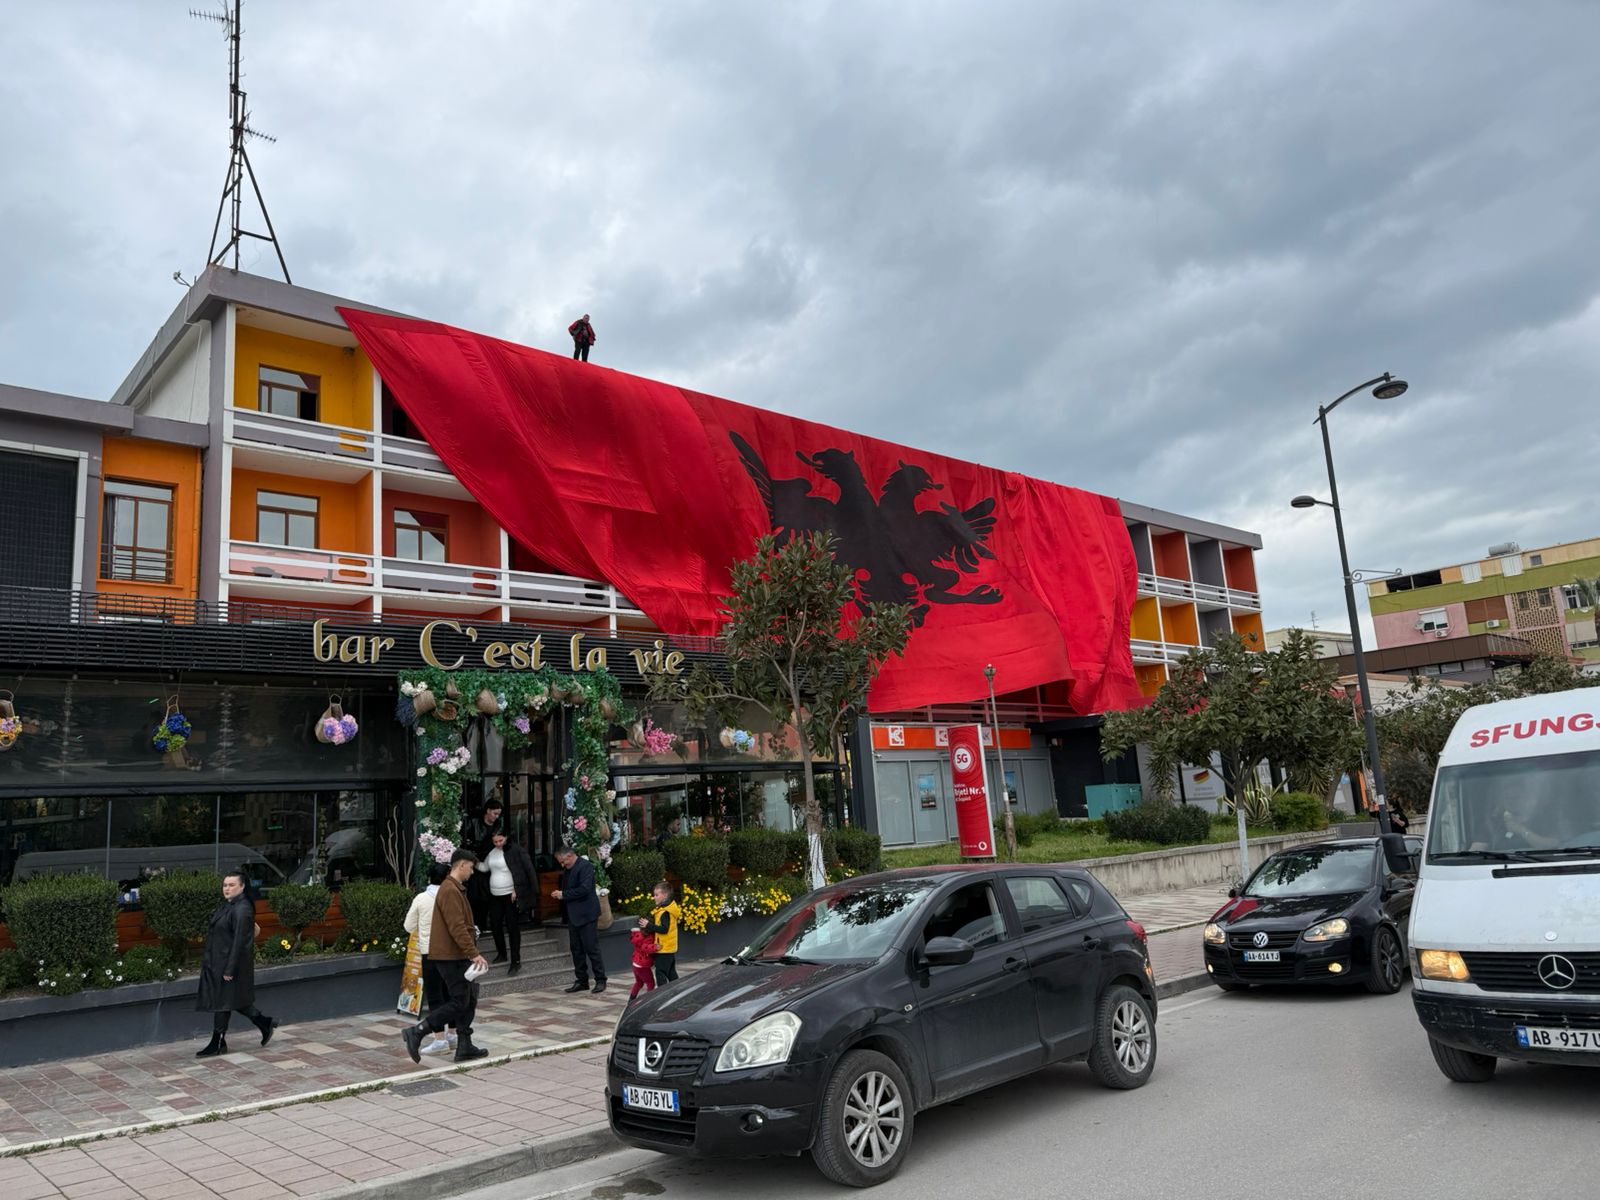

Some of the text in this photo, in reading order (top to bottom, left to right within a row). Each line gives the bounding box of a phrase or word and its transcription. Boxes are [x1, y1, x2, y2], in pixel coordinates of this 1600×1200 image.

[313, 618, 685, 675] bar C'est la vie
[1470, 713, 1600, 748] SFUNG
[956, 753, 968, 764] 5G
